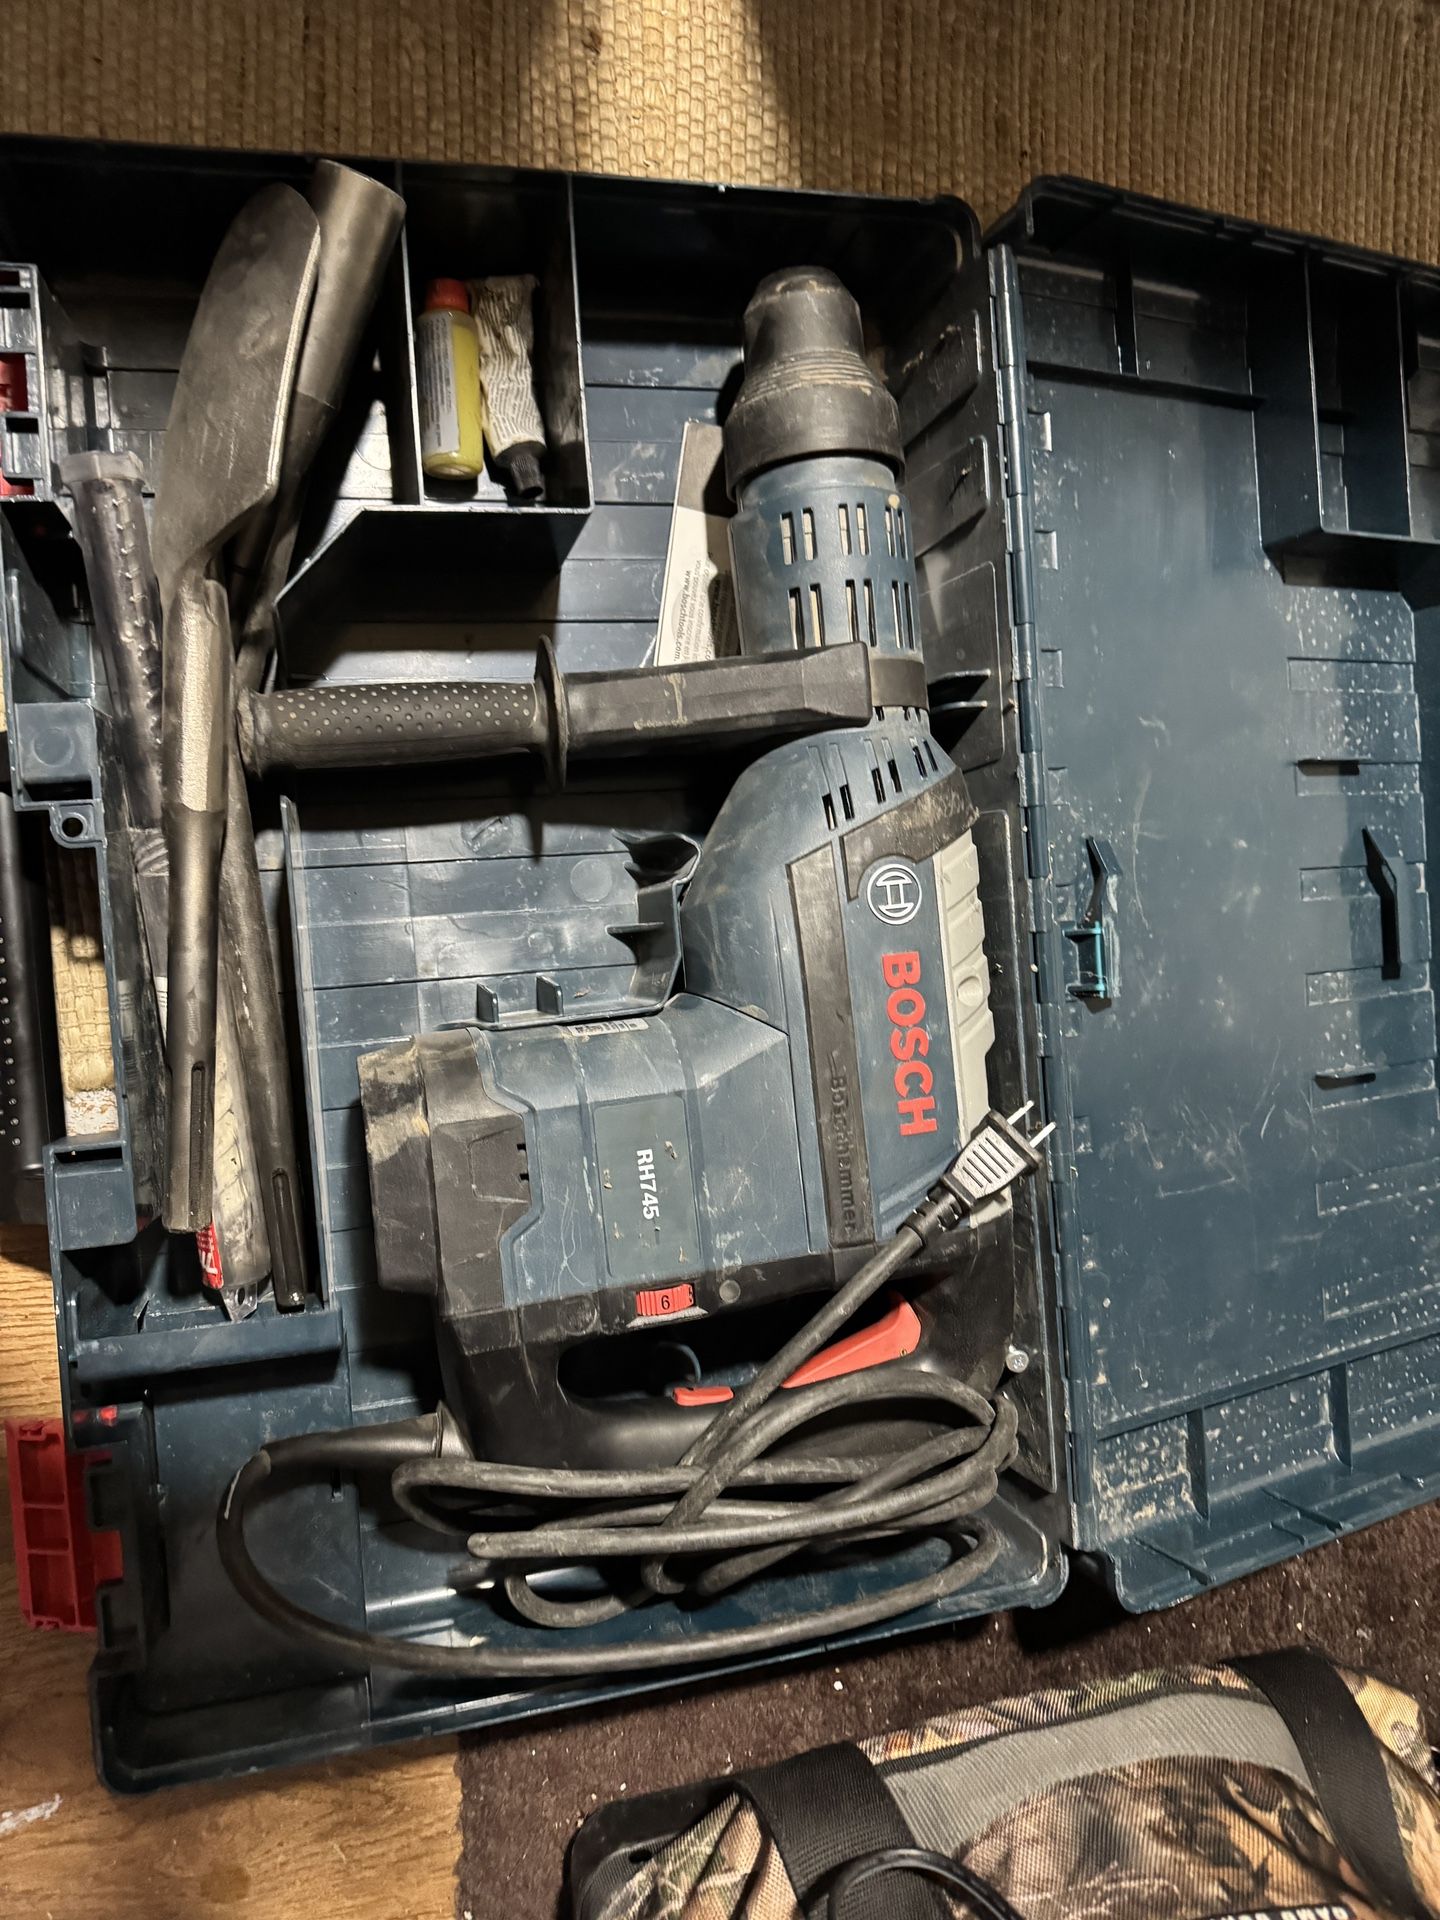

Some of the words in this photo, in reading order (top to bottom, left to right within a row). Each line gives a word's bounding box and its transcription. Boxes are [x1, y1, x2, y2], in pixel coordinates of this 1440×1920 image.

[674, 570, 692, 662] www.boschtools.com.
[882, 951, 938, 1136] BOSCH
[636, 1149, 660, 1220] RH745
[831, 1075, 857, 1231] Boschhammer
[661, 1295, 670, 1310] 6
